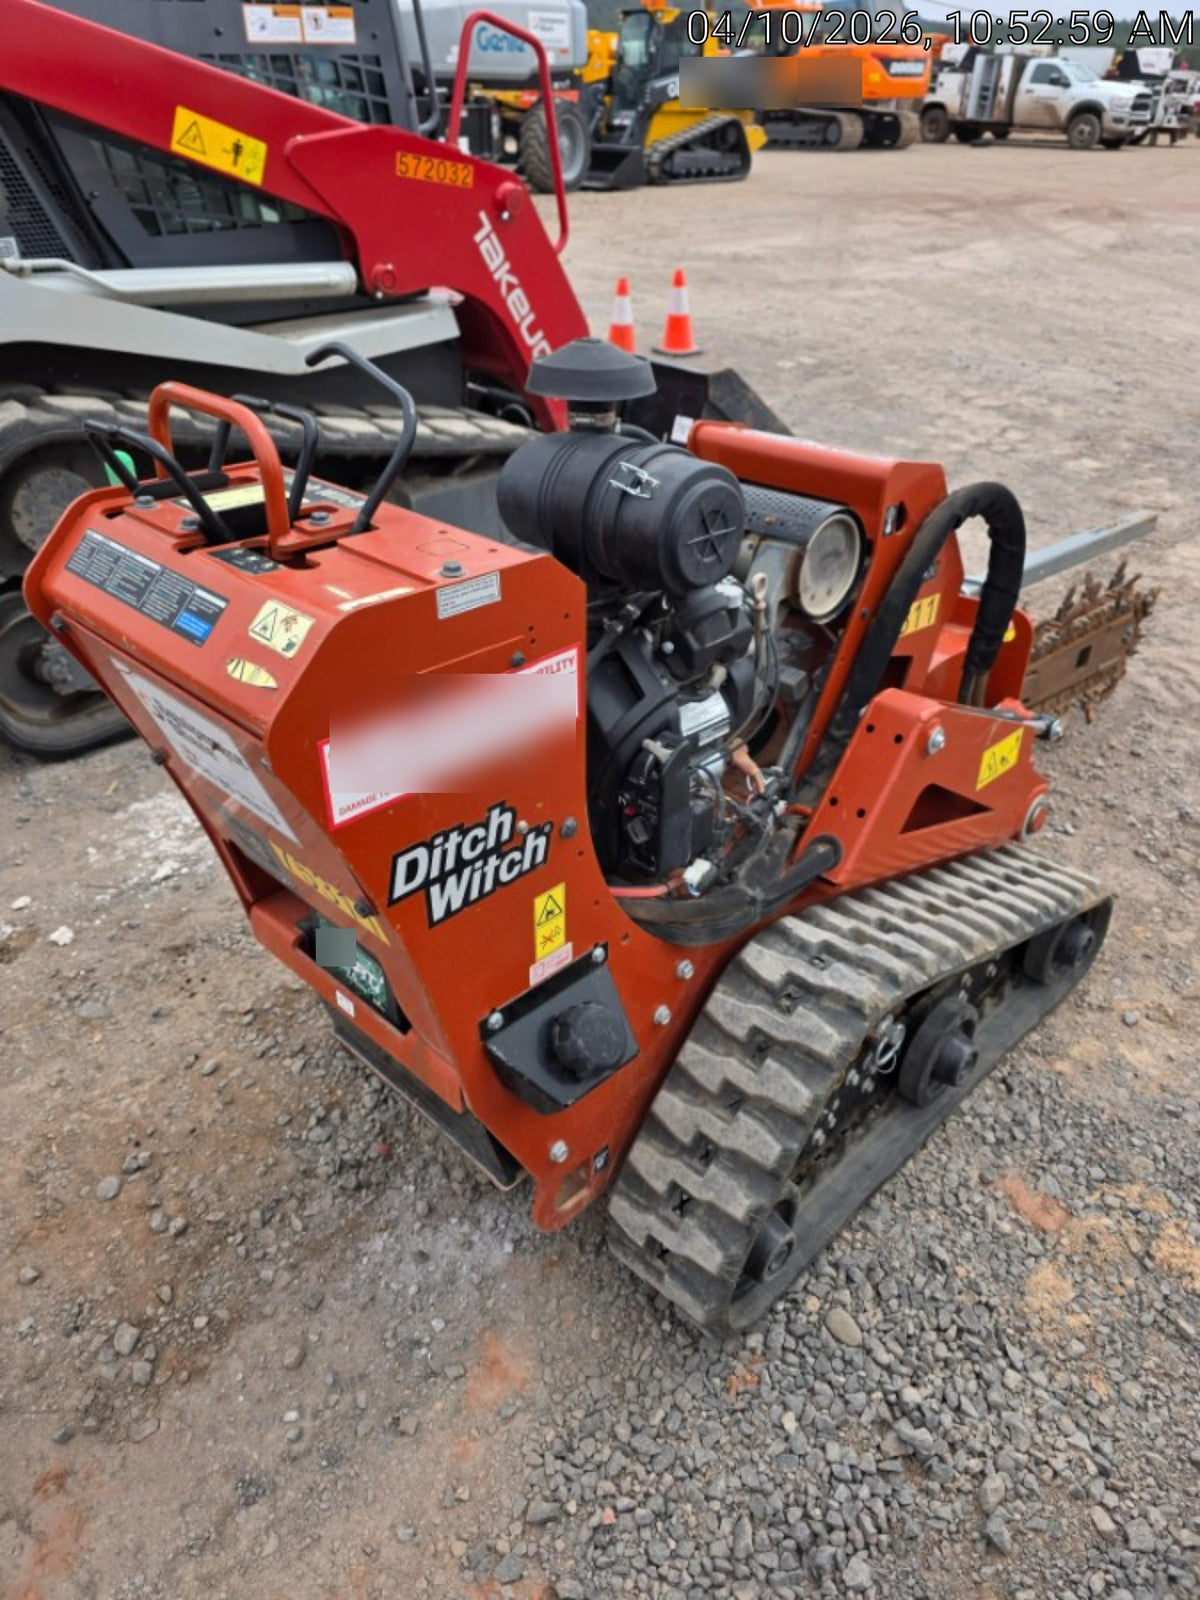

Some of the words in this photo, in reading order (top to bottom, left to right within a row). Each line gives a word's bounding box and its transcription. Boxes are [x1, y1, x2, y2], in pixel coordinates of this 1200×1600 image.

[398, 153, 470, 186] 572032
[392, 806, 513, 900] Ditch
[429, 830, 548, 923] Witch
